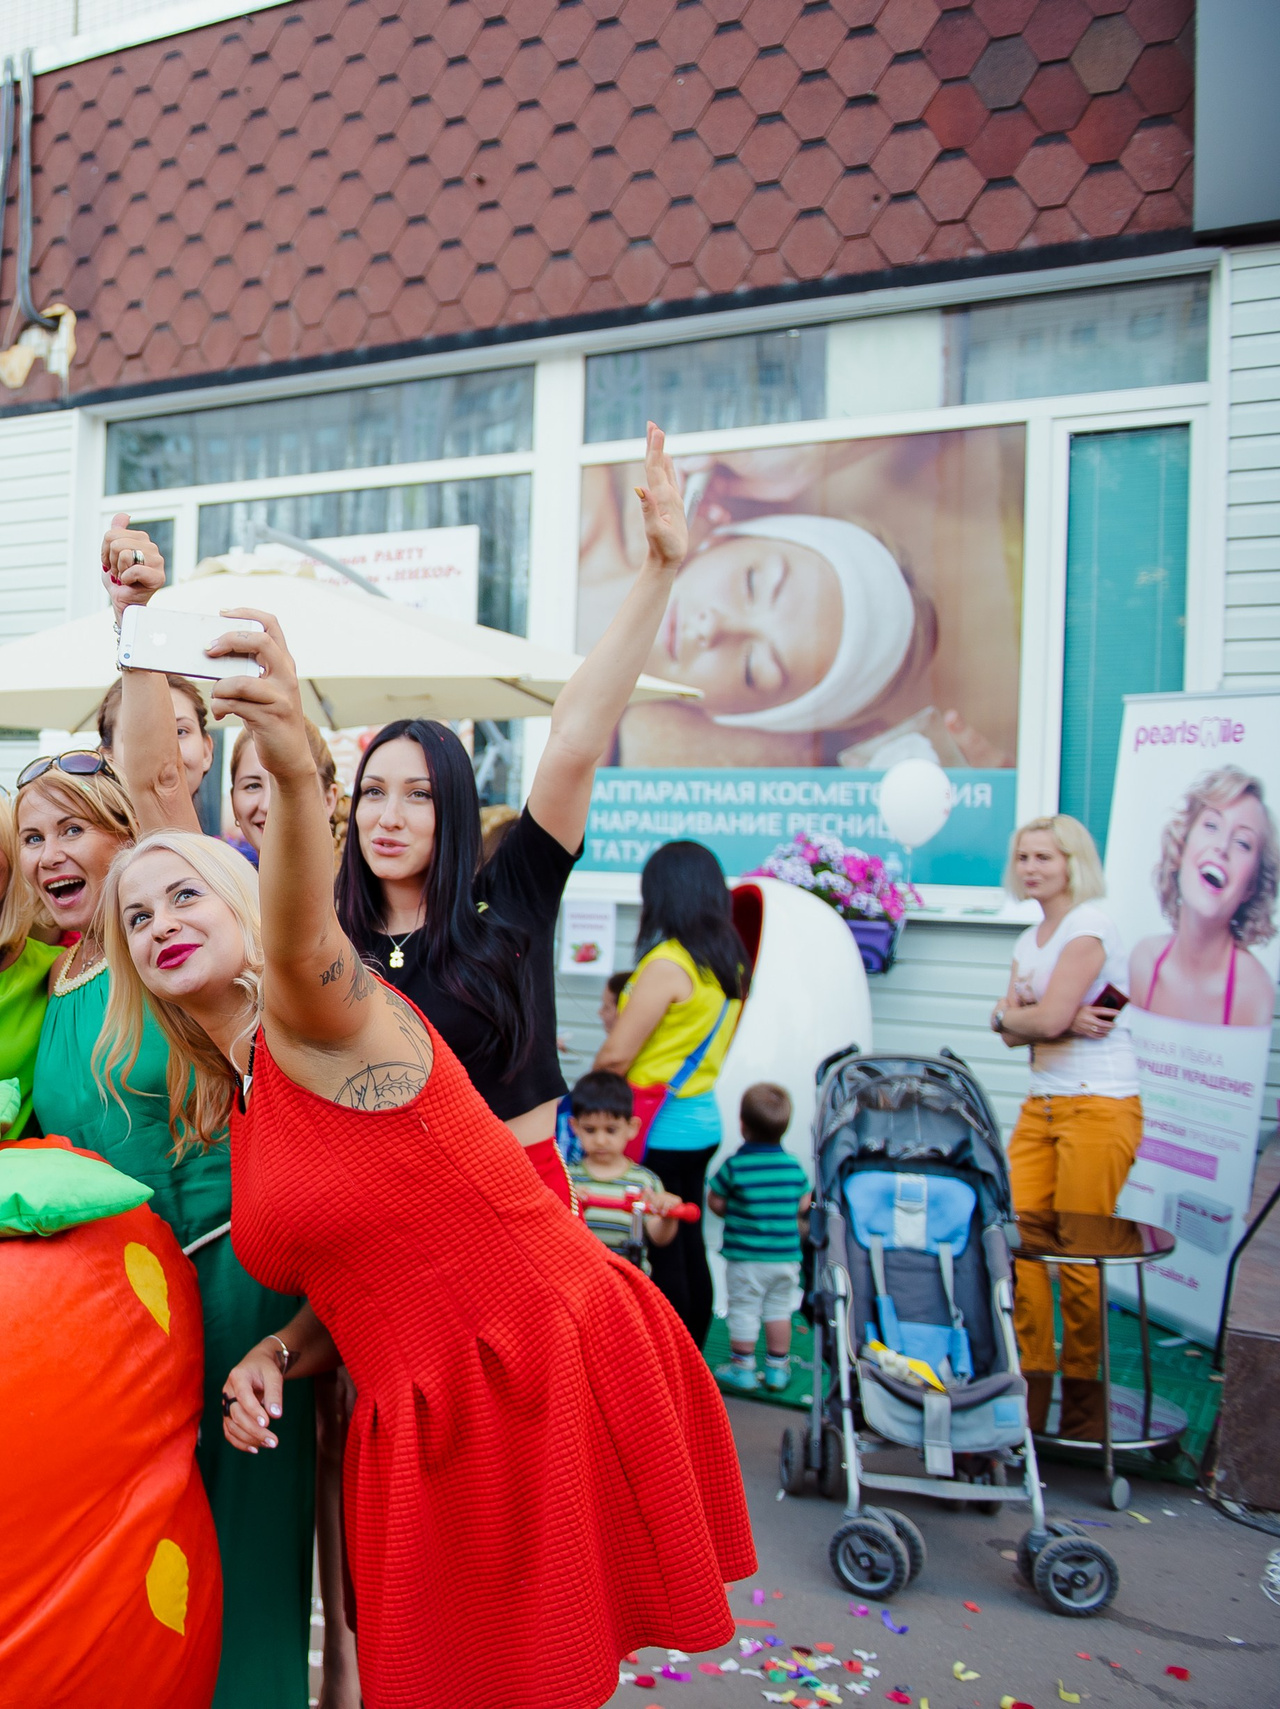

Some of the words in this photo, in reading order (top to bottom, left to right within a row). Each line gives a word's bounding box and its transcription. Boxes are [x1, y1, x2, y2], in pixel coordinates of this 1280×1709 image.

[593, 779, 756, 806] АППАРАТНАЯ
[759, 780, 993, 809] КОСМЕТИЯ
[590, 809, 783, 837] НАРАЩИВАНИЕ
